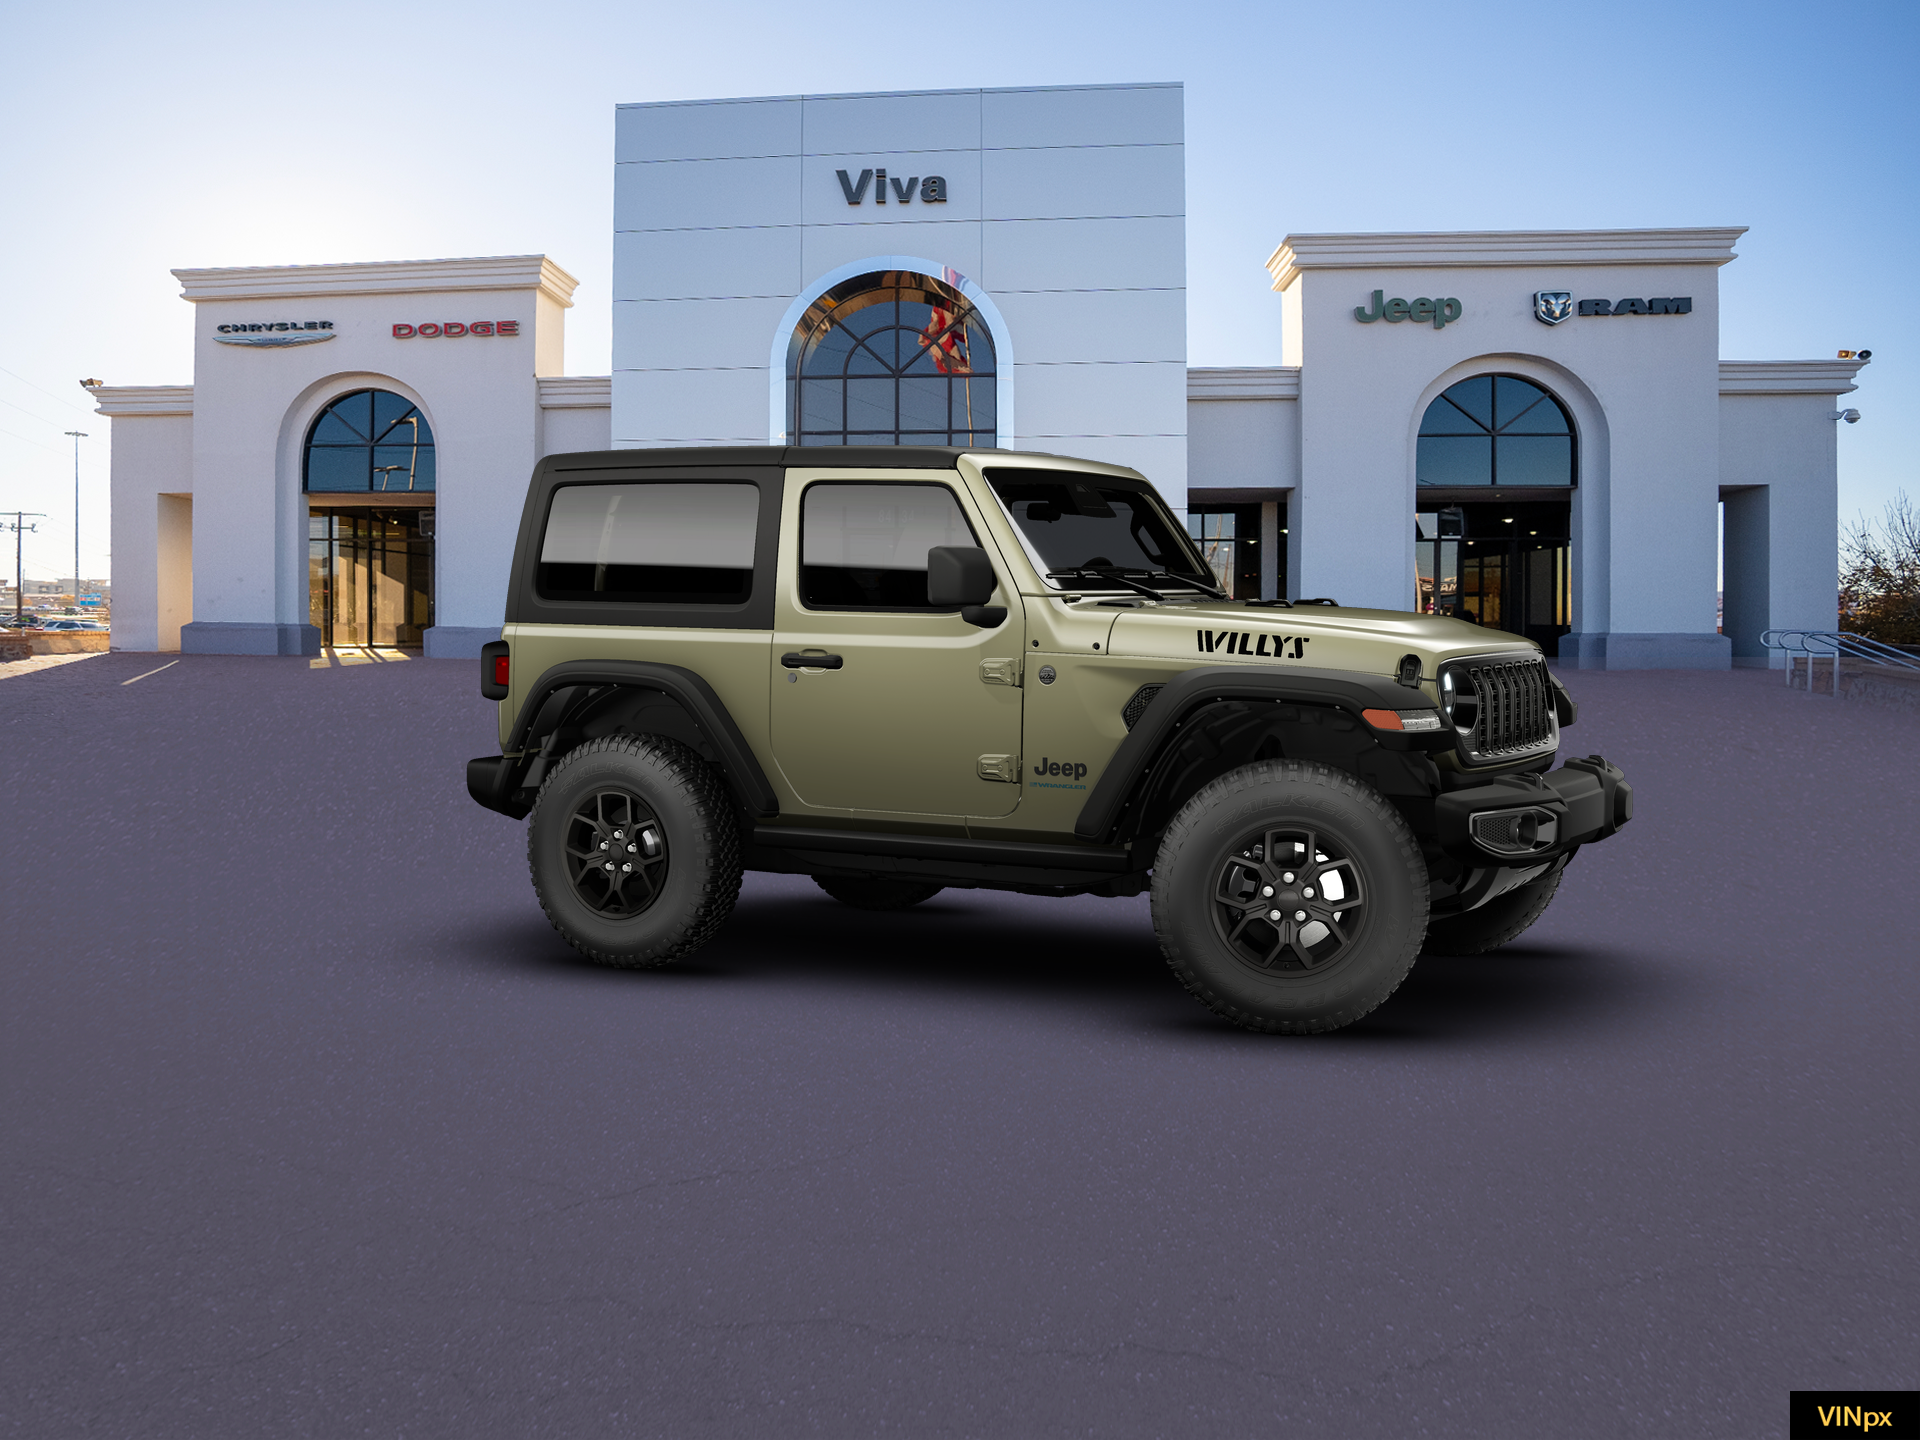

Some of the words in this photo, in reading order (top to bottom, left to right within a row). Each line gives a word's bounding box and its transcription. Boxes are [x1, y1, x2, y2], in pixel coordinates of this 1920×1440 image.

[836, 168, 947, 205] Viva
[1354, 289, 1462, 329] Jeep
[1579, 297, 1692, 316] RAM
[216, 320, 334, 333] CHRYSLER
[392, 320, 519, 339] DODGE
[1197, 629, 1310, 659] WILLYS
[1034, 757, 1087, 781] Jeep
[1037, 782, 1086, 790] WRANGLER
[1211, 793, 1366, 834] FALKEN
